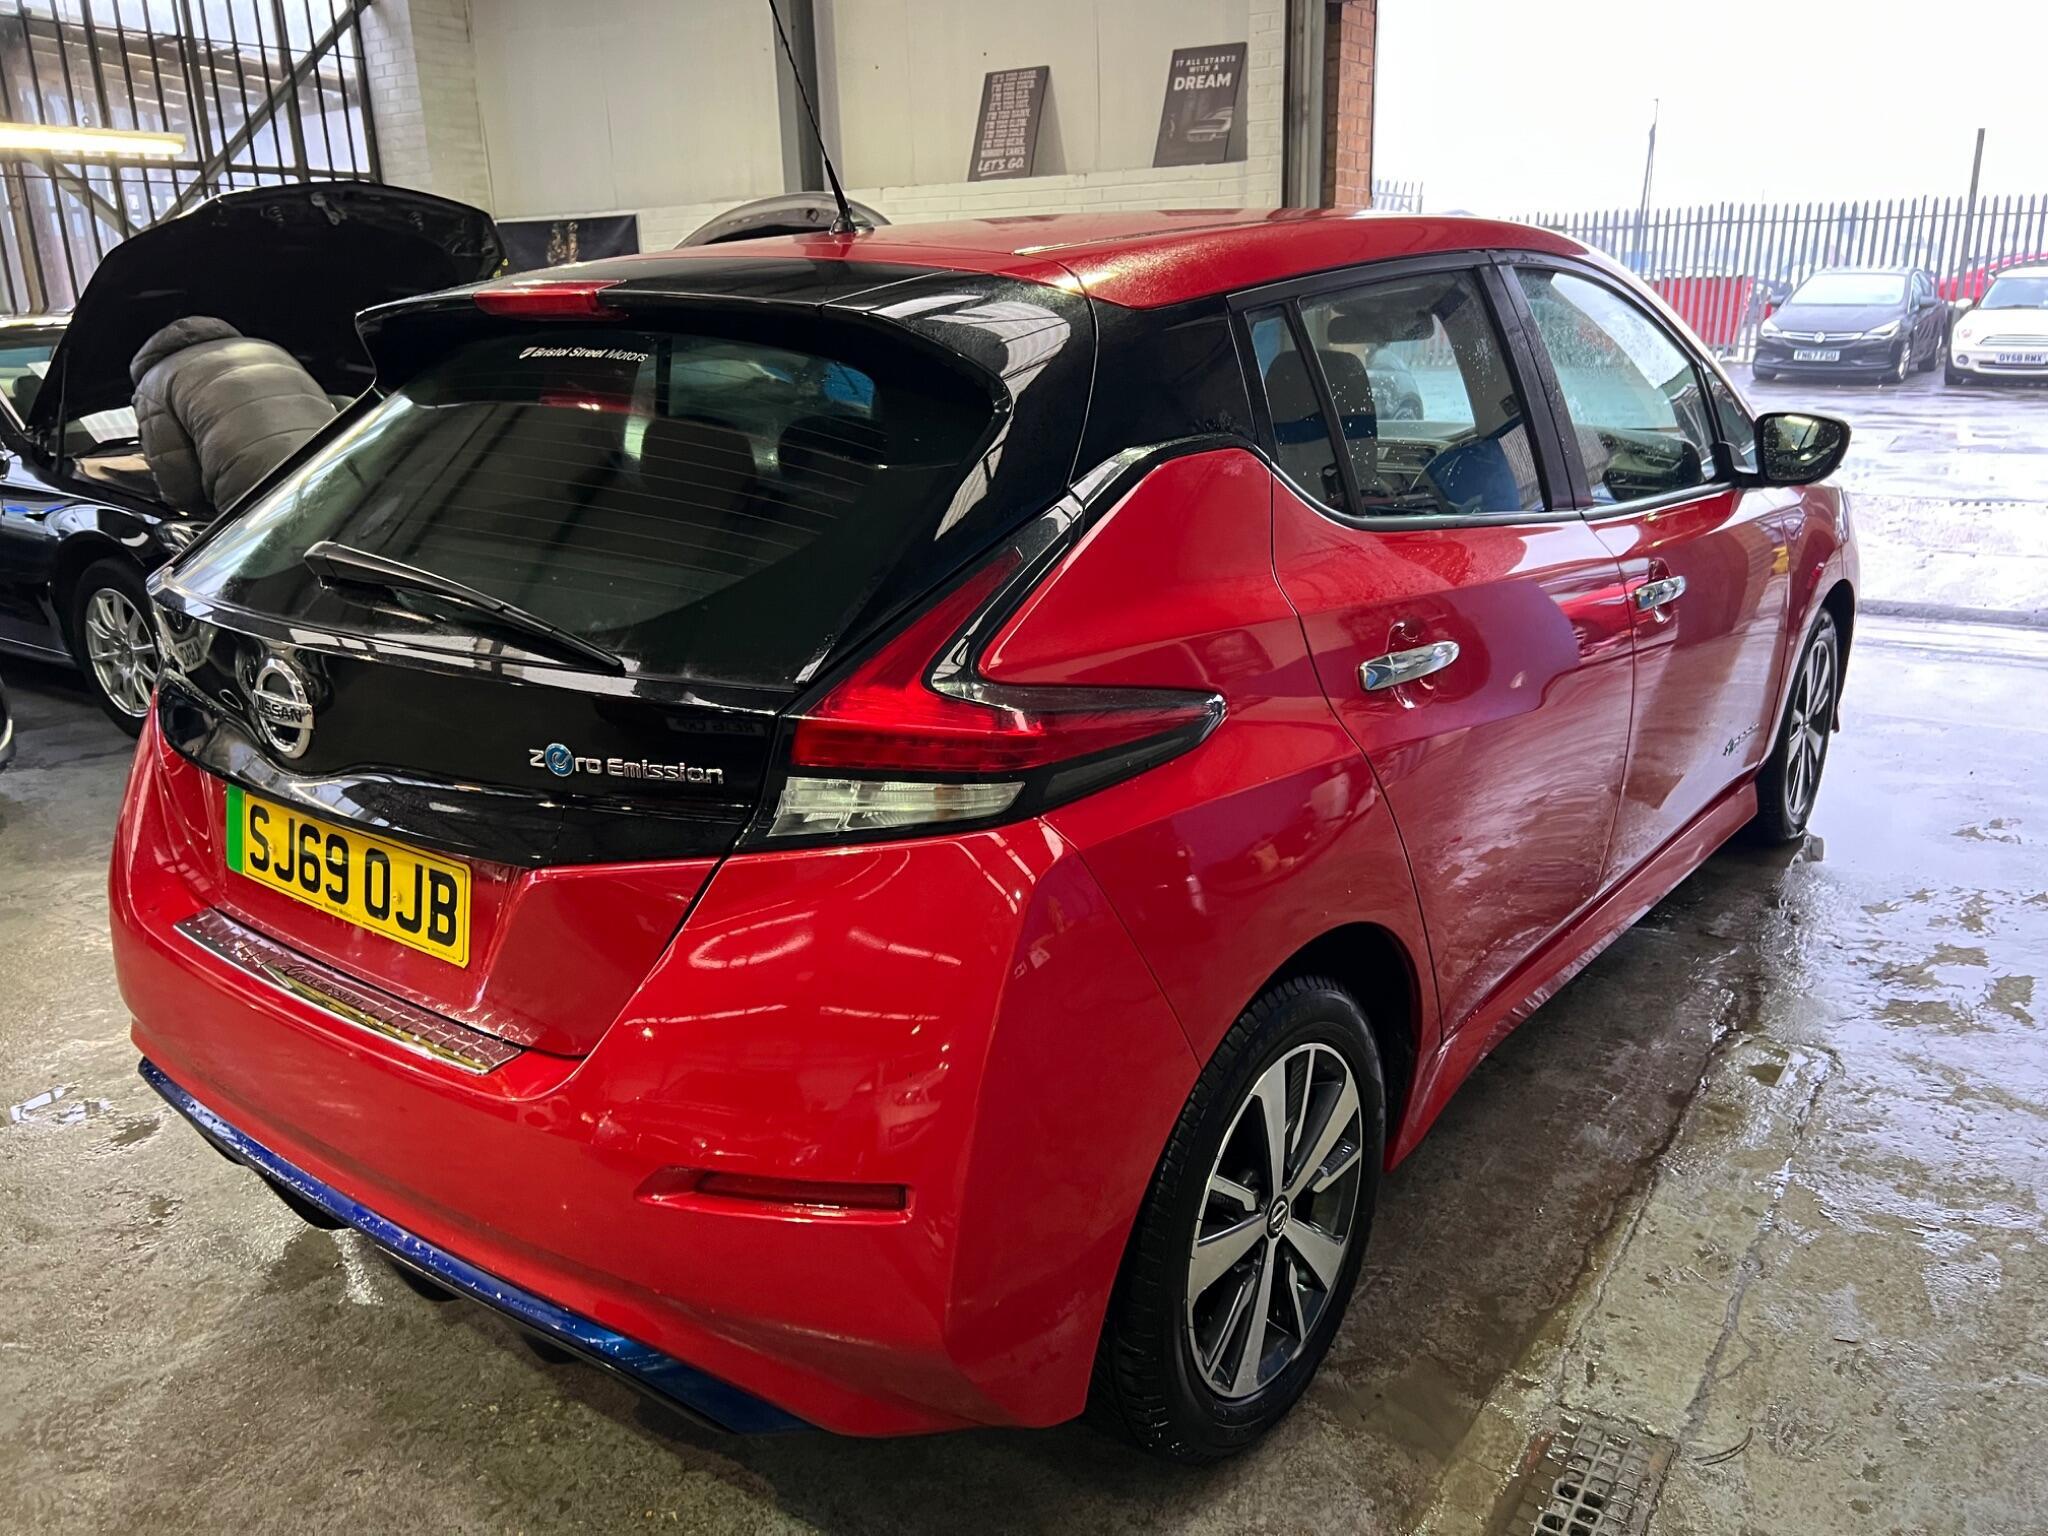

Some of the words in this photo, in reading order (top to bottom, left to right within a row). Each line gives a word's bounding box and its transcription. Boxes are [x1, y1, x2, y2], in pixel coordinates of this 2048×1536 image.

[1186, 58, 1200, 66] ALL
[1204, 55, 1236, 64] STARTS
[1174, 72, 1232, 91] DREAM
[978, 158, 1006, 172] LET'S
[531, 346, 572, 358] Bristol
[569, 346, 609, 359] Street
[605, 349, 649, 362] Motors
[607, 758, 724, 785] Emission
[250, 804, 349, 905] SJ69
[364, 847, 458, 948] OJB
